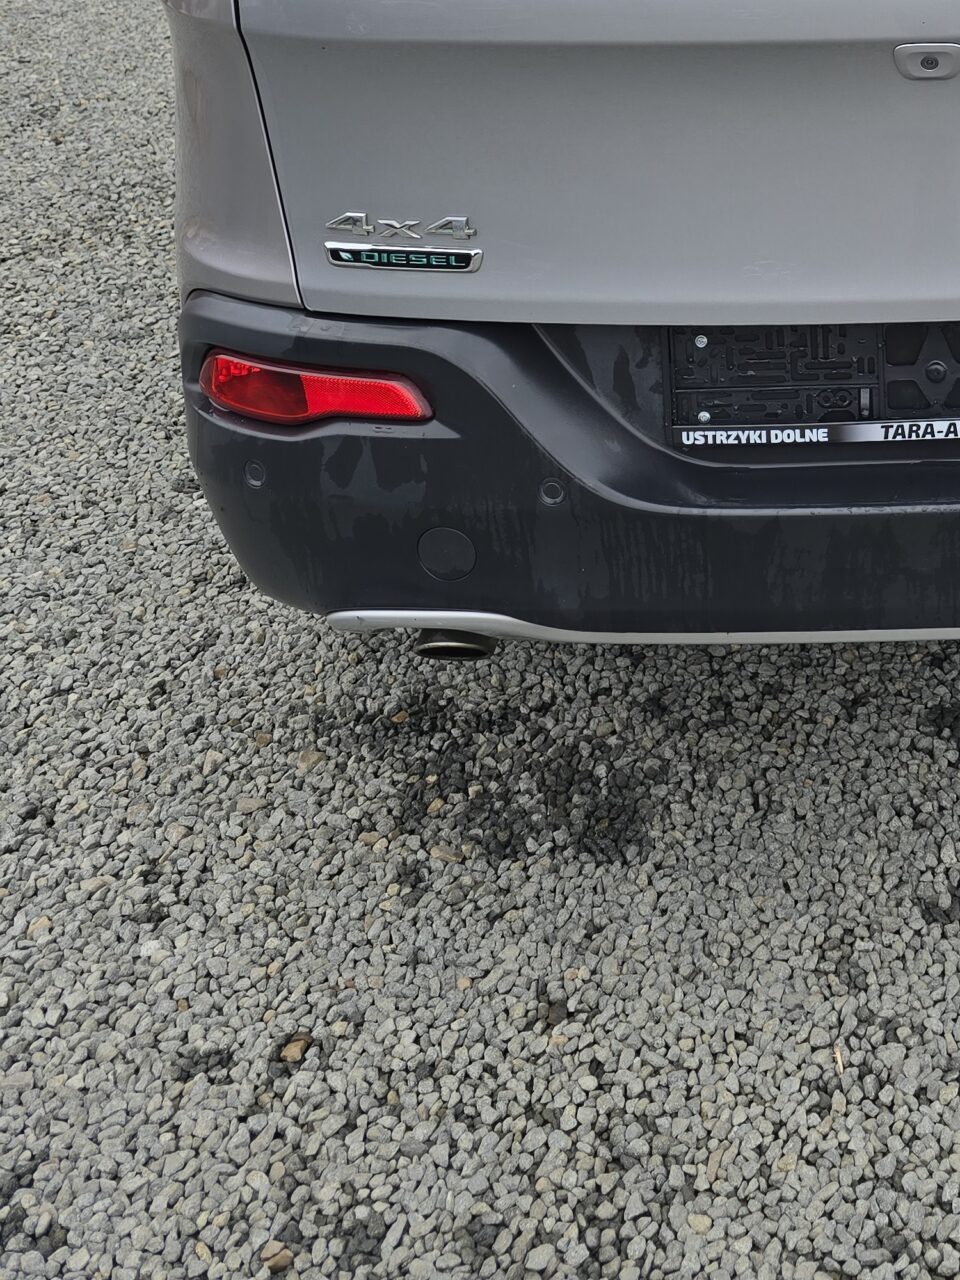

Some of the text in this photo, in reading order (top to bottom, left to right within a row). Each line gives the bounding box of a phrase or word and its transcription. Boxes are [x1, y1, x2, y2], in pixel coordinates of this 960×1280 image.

[325, 211, 477, 240] 4x4
[360, 251, 466, 266] DIESEL
[681, 428, 829, 445] USTRZYKI DOLNE
